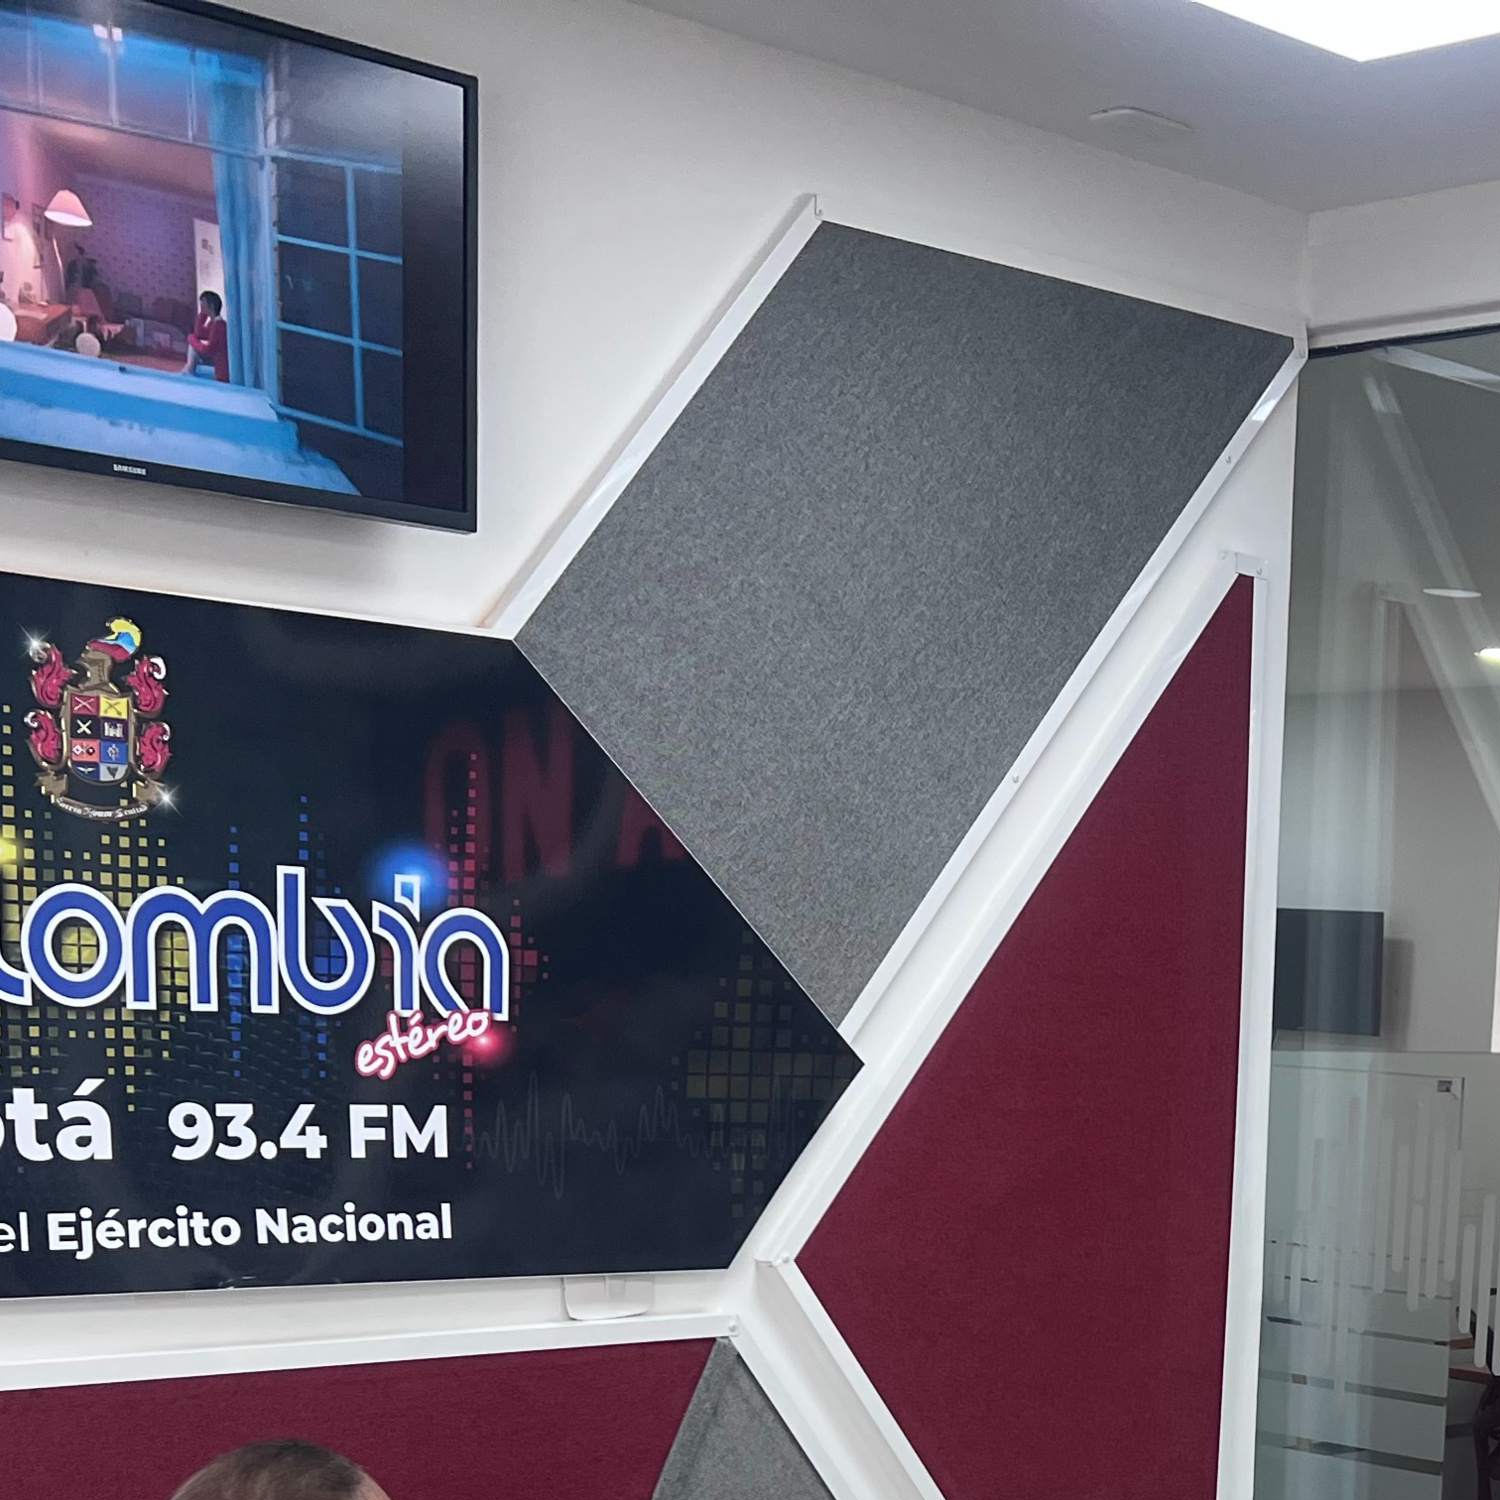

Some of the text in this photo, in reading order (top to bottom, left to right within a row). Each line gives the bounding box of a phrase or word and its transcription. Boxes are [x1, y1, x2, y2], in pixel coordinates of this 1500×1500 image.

[0, 865, 509, 1021] ombia
[356, 1009, 490, 1078] estéreo
[0, 1078, 449, 1161] tá 93.4 FM
[47, 1206, 241, 1260] Ejército
[256, 1203, 452, 1244] Nacional
